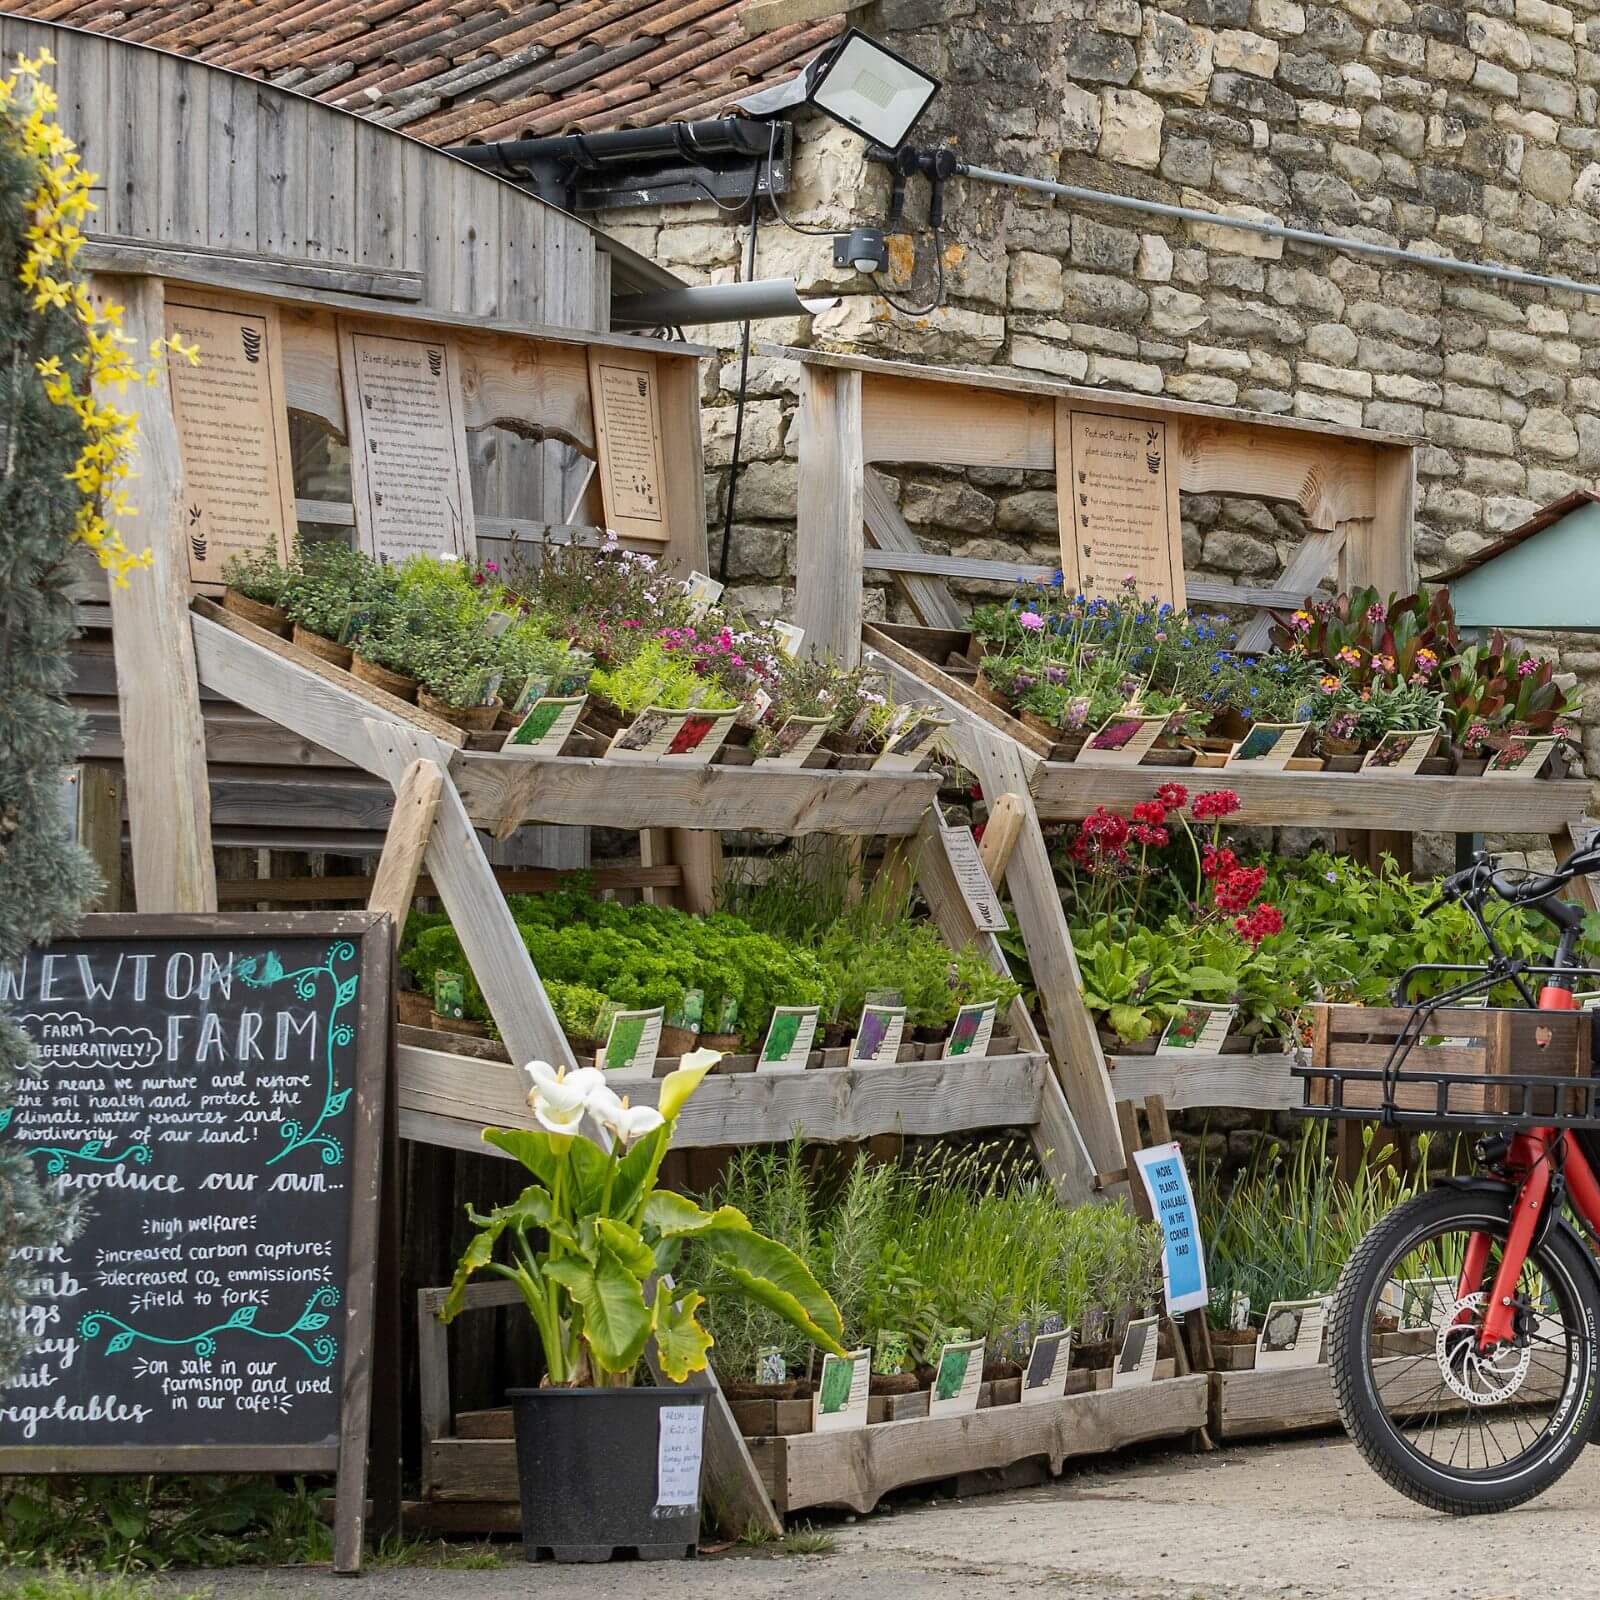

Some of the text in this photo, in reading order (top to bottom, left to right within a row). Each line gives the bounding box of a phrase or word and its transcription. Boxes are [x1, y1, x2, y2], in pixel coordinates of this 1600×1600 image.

[0, 951, 234, 1001] NEWTON
[43, 1023, 84, 1038] FARM
[167, 1010, 318, 1062] FARM
[36, 1042, 152, 1058] EGENERATIVELY!
[16, 1071, 312, 1091] this means we nurture and restore
[15, 1090, 301, 1109] the soil health and protect the
[94, 1111, 140, 1123] water
[234, 1107, 286, 1122] and
[14, 1126, 258, 1148] biodiversity of our land!
[58, 1163, 184, 1197] produce
[199, 1170, 258, 1192] our
[1155, 1165, 1173, 1178] MORE
[1158, 1180, 1179, 1194] PLANTS
[1160, 1194, 1187, 1211] AVAILABLE
[151, 1215, 249, 1240] high welfare
[1168, 1211, 1185, 1226] IN THE
[1169, 1227, 1189, 1242] CORNER
[9, 1241, 323, 1263] ork increased carbon capture
[1175, 1244, 1189, 1257] YARD
[107, 1268, 188, 1286] decreased
[228, 1265, 321, 1283] emmissions
[140, 1290, 184, 1310] field
[194, 1294, 211, 1306] to
[221, 1288, 260, 1307] fork
[150, 1357, 277, 1375] on sale in our
[161, 1377, 243, 1395] farmshop
[252, 1376, 288, 1393] and
[296, 1376, 333, 1394] used
[172, 1394, 187, 1410] in
[197, 1396, 225, 1410] our
